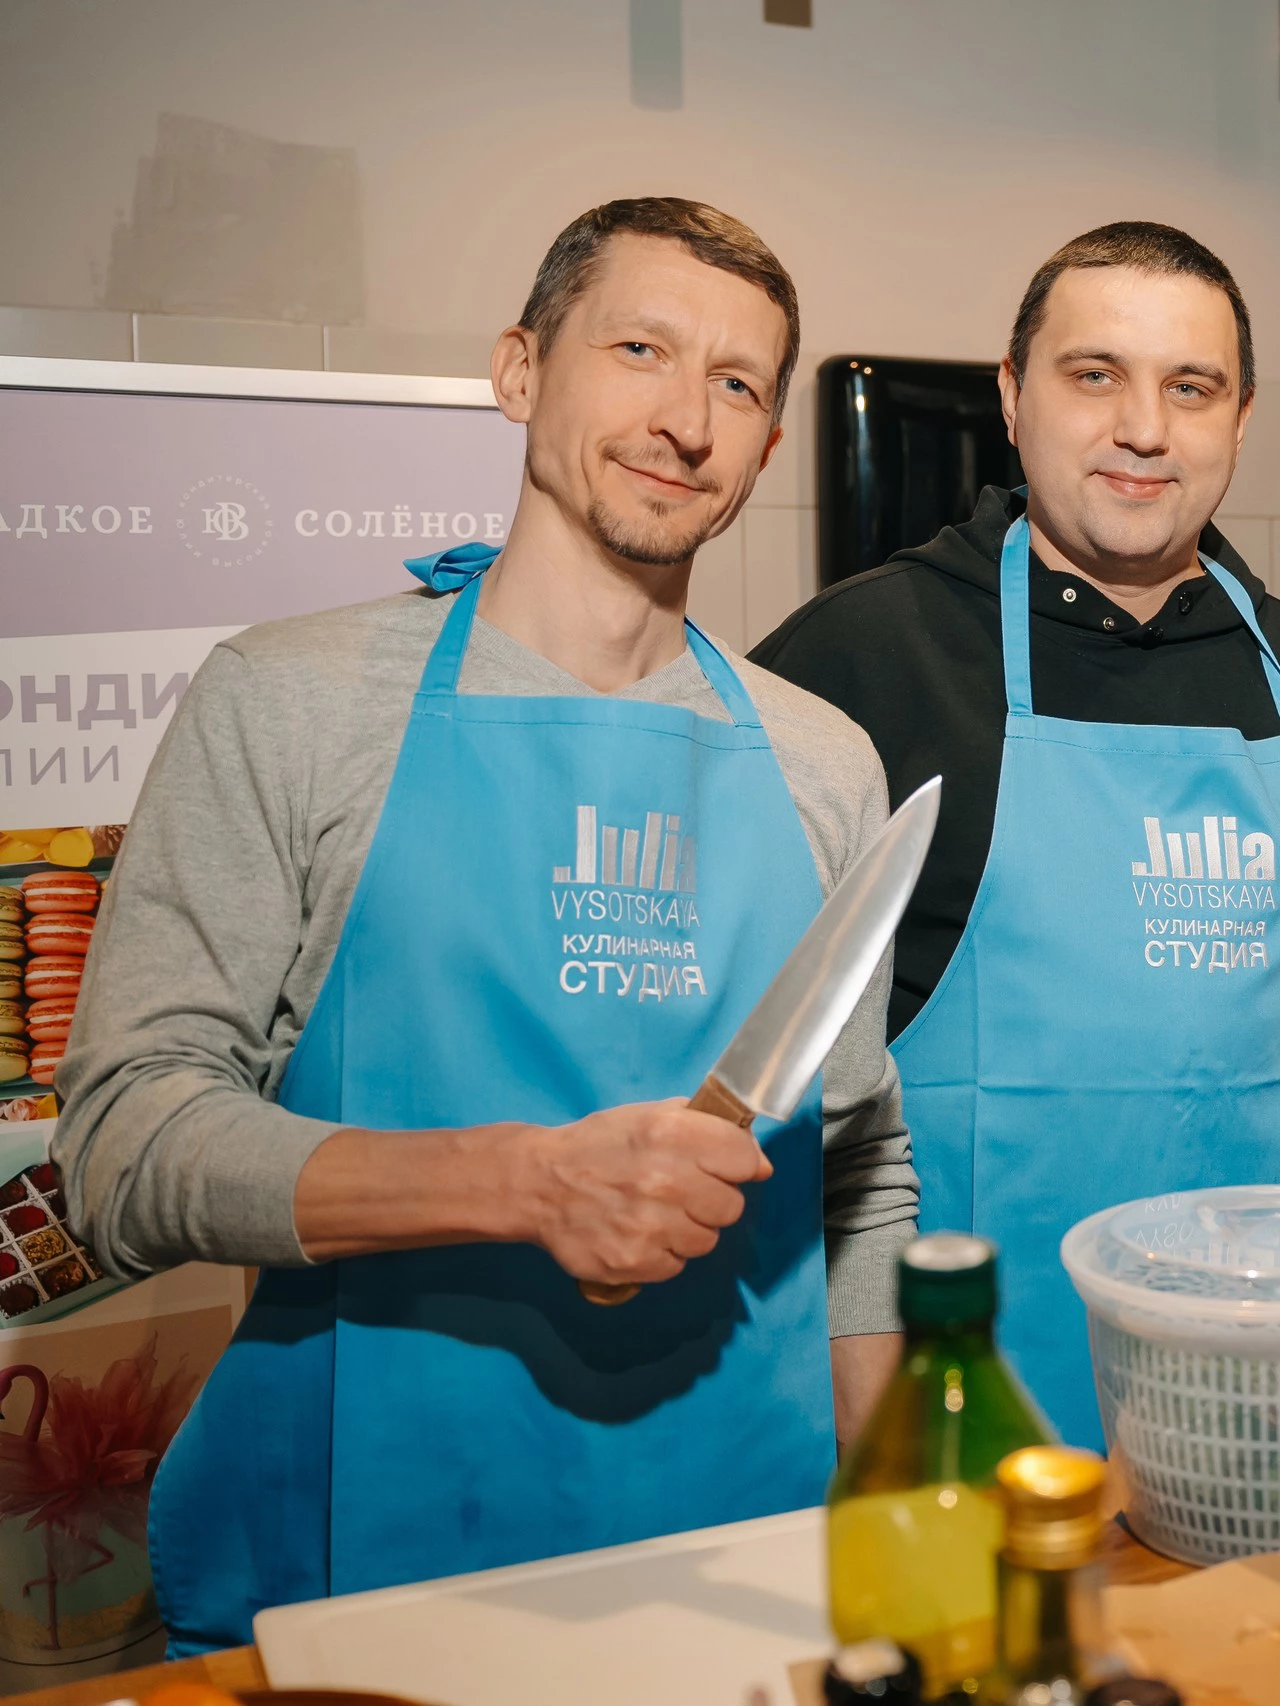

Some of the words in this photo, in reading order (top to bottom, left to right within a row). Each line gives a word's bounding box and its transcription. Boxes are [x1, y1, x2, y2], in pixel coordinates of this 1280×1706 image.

[294, 505, 505, 539] СОЛЁНОЕ
[0, 672, 189, 731] НДИ
[553, 806, 695, 891] Julia
[1132, 816, 1274, 879] Julia
[552, 890, 699, 927] VYSOTSKAYA
[1133, 882, 1275, 908] VYSOTSKAYA
[1145, 919, 1264, 935] КУЛИНАРНАЯ
[563, 935, 695, 958] КУЛИНАРНАЯ
[1144, 940, 1267, 972] СТУДИЯ
[560, 961, 706, 1001] СТУДИЯ
